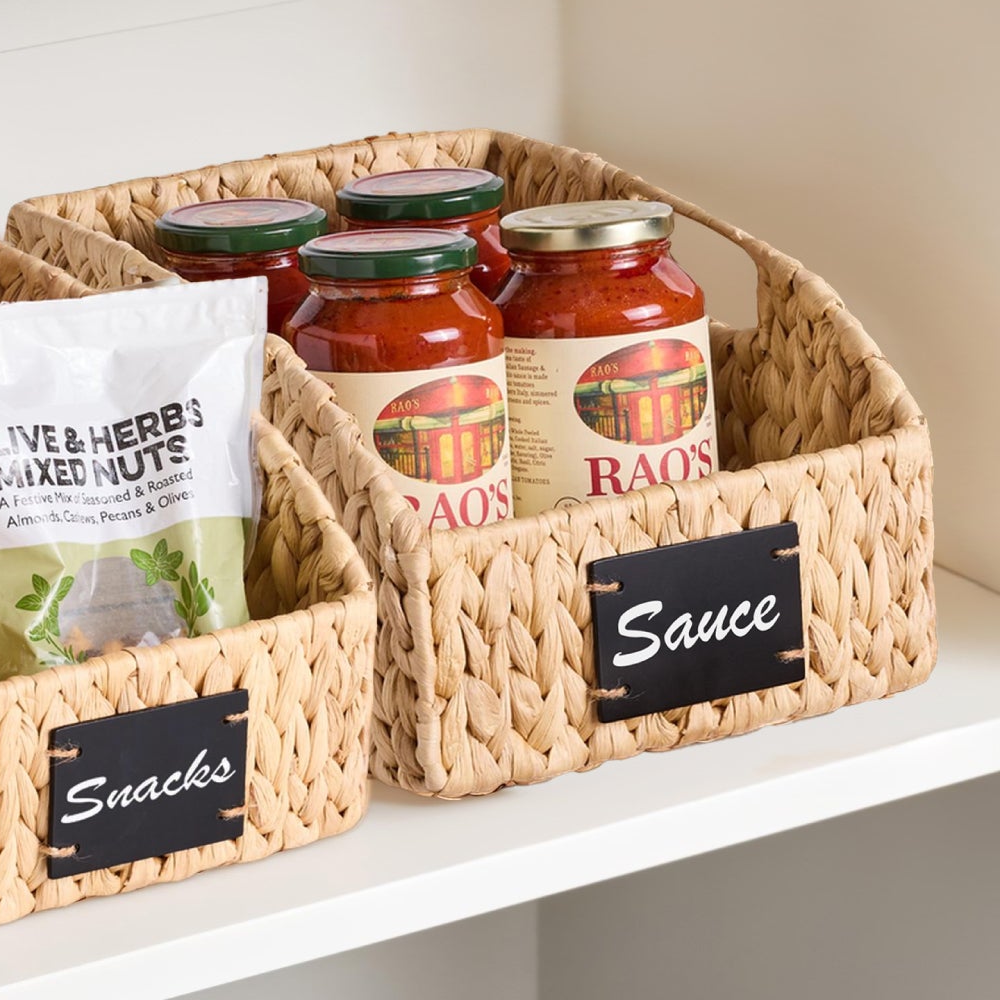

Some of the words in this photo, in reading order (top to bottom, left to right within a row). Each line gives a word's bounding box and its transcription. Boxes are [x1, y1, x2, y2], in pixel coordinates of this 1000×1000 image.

[590, 362, 620, 378] RAO'S
[64, 426, 87, 454] &
[89, 398, 205, 454] HERBS
[391, 398, 420, 414] RAO'S
[92, 434, 191, 487] NUTS
[584, 439, 714, 498] RAO'S
[7, 510, 63, 529] Almonds,
[100, 508, 142, 523] Pecans
[145, 502, 156, 515] &
[157, 489, 195, 509] Olives
[13, 493, 53, 508] Festive
[54, 492, 73, 504] Mix
[81, 488, 132, 506] Seasoned
[135, 486, 146, 497] &
[147, 468, 194, 494] Roasted
[404, 478, 511, 530] AO'S
[612, 594, 781, 667] Sauce
[60, 748, 237, 824] Snacks
